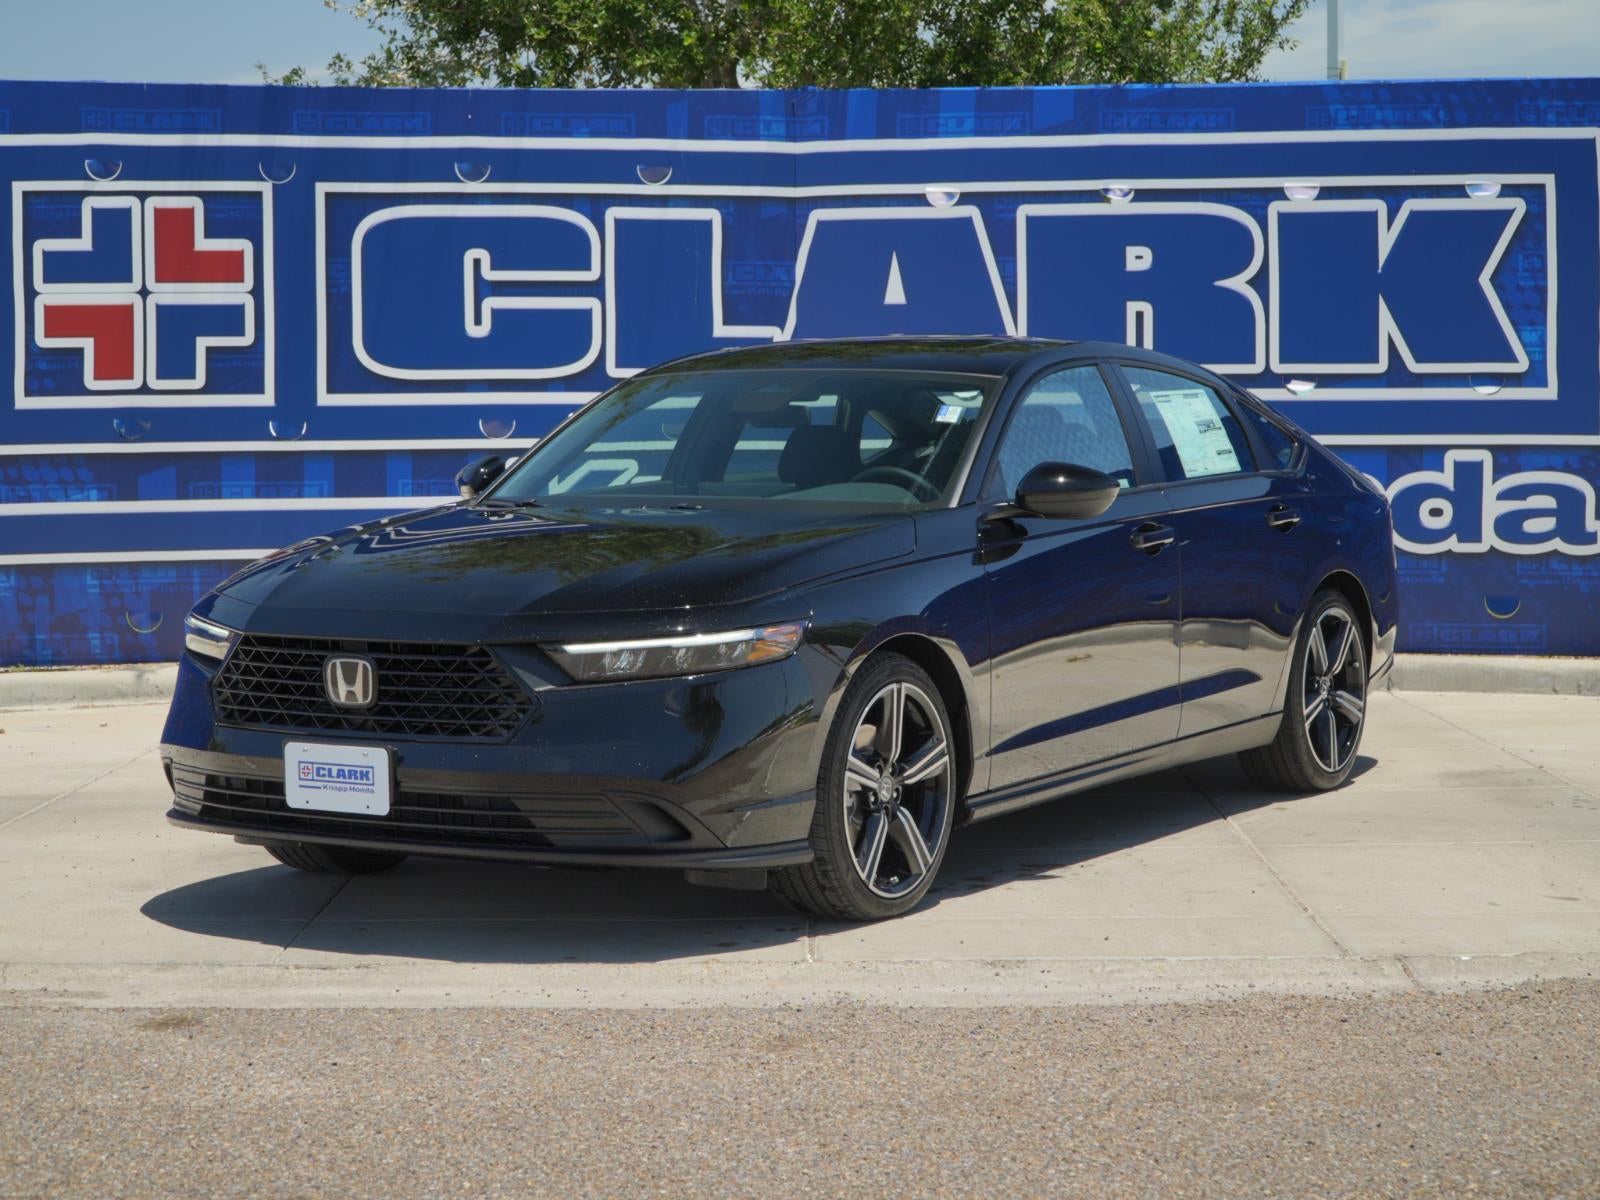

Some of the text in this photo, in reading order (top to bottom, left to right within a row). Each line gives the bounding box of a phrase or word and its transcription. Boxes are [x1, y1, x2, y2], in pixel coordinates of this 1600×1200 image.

[352, 198, 1529, 380] CLARK
[315, 766, 371, 781] CLARK
[322, 784, 375, 794] Knapp Honda
